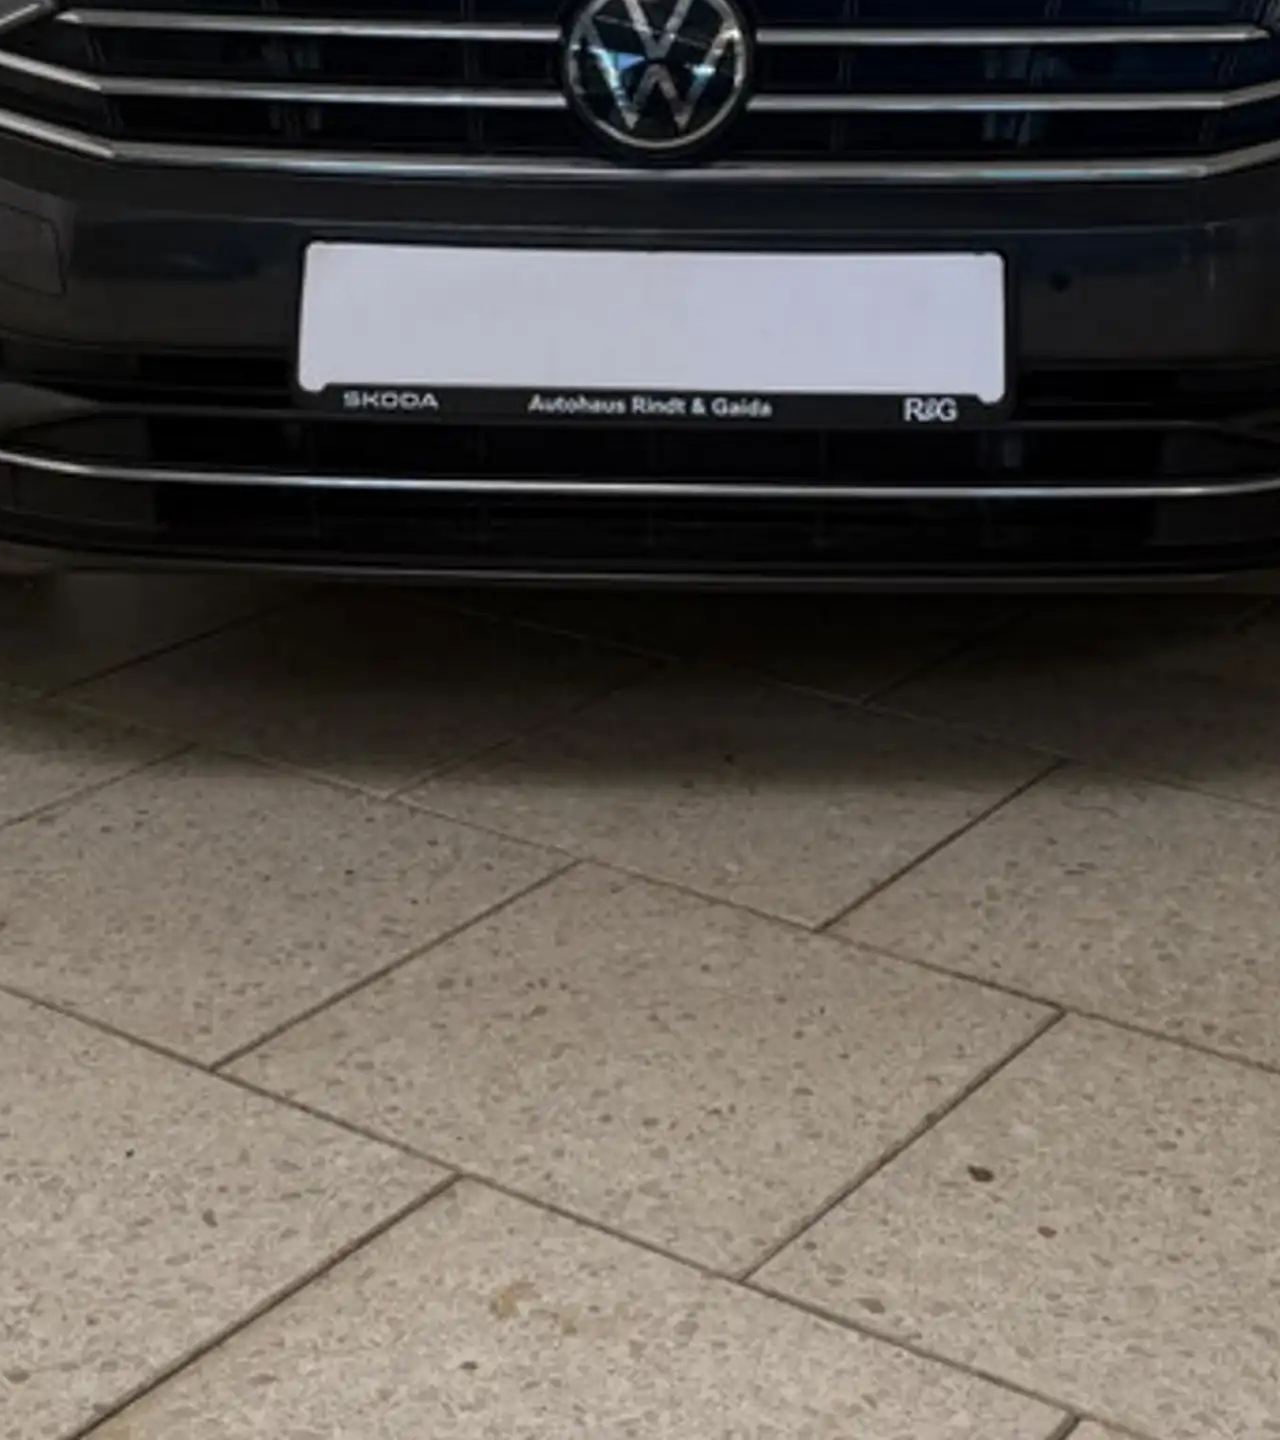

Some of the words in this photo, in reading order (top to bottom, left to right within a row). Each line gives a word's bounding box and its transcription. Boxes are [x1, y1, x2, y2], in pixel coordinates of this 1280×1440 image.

[527, 393, 627, 414] Autohaus
[631, 394, 687, 416] Rindt
[690, 396, 707, 416] &
[711, 396, 773, 418] Gaida
